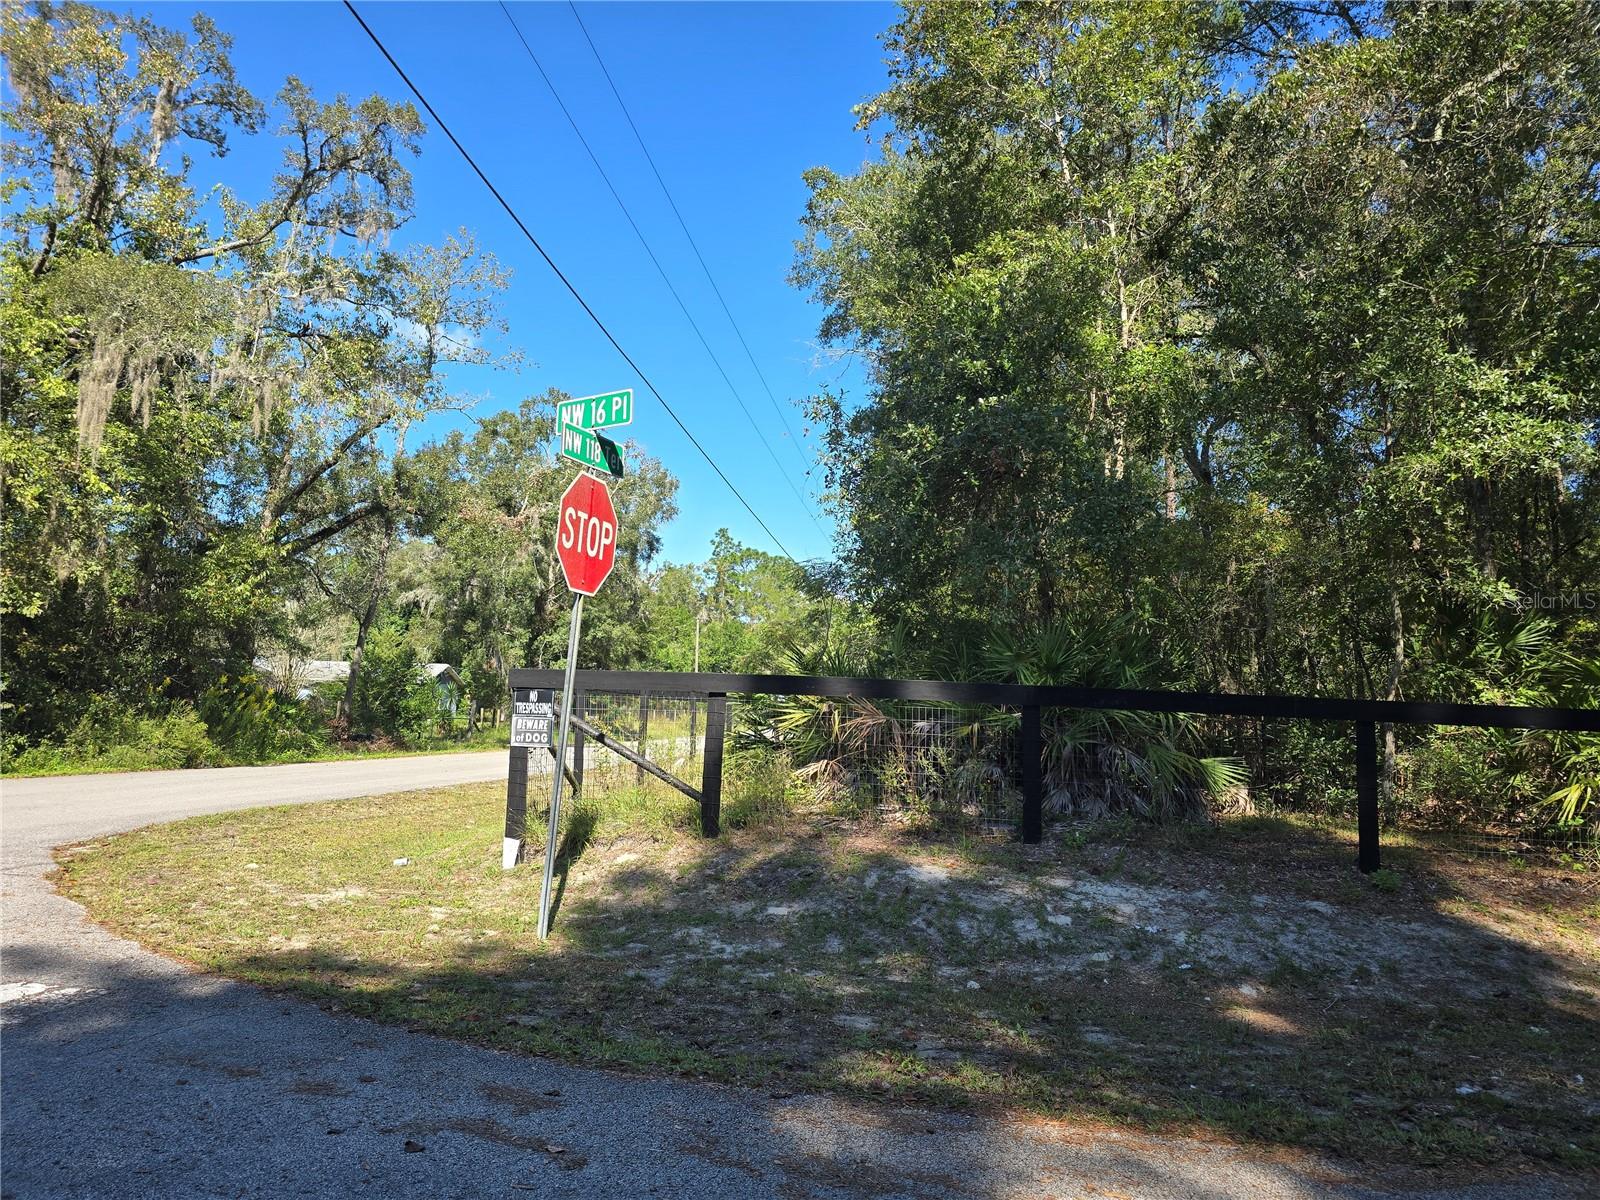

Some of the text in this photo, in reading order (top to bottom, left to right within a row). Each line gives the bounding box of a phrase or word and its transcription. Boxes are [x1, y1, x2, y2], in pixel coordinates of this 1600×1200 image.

[562, 403, 585, 427] NW
[591, 400, 606, 427] 16
[566, 429, 582, 455] NW
[586, 438, 601, 463] 118
[562, 507, 613, 560] STOP
[529, 690, 538, 702] NO
[516, 702, 551, 714] TRESPASSING
[517, 719, 548, 730] BEWARE
[516, 733, 548, 743] of DOG
